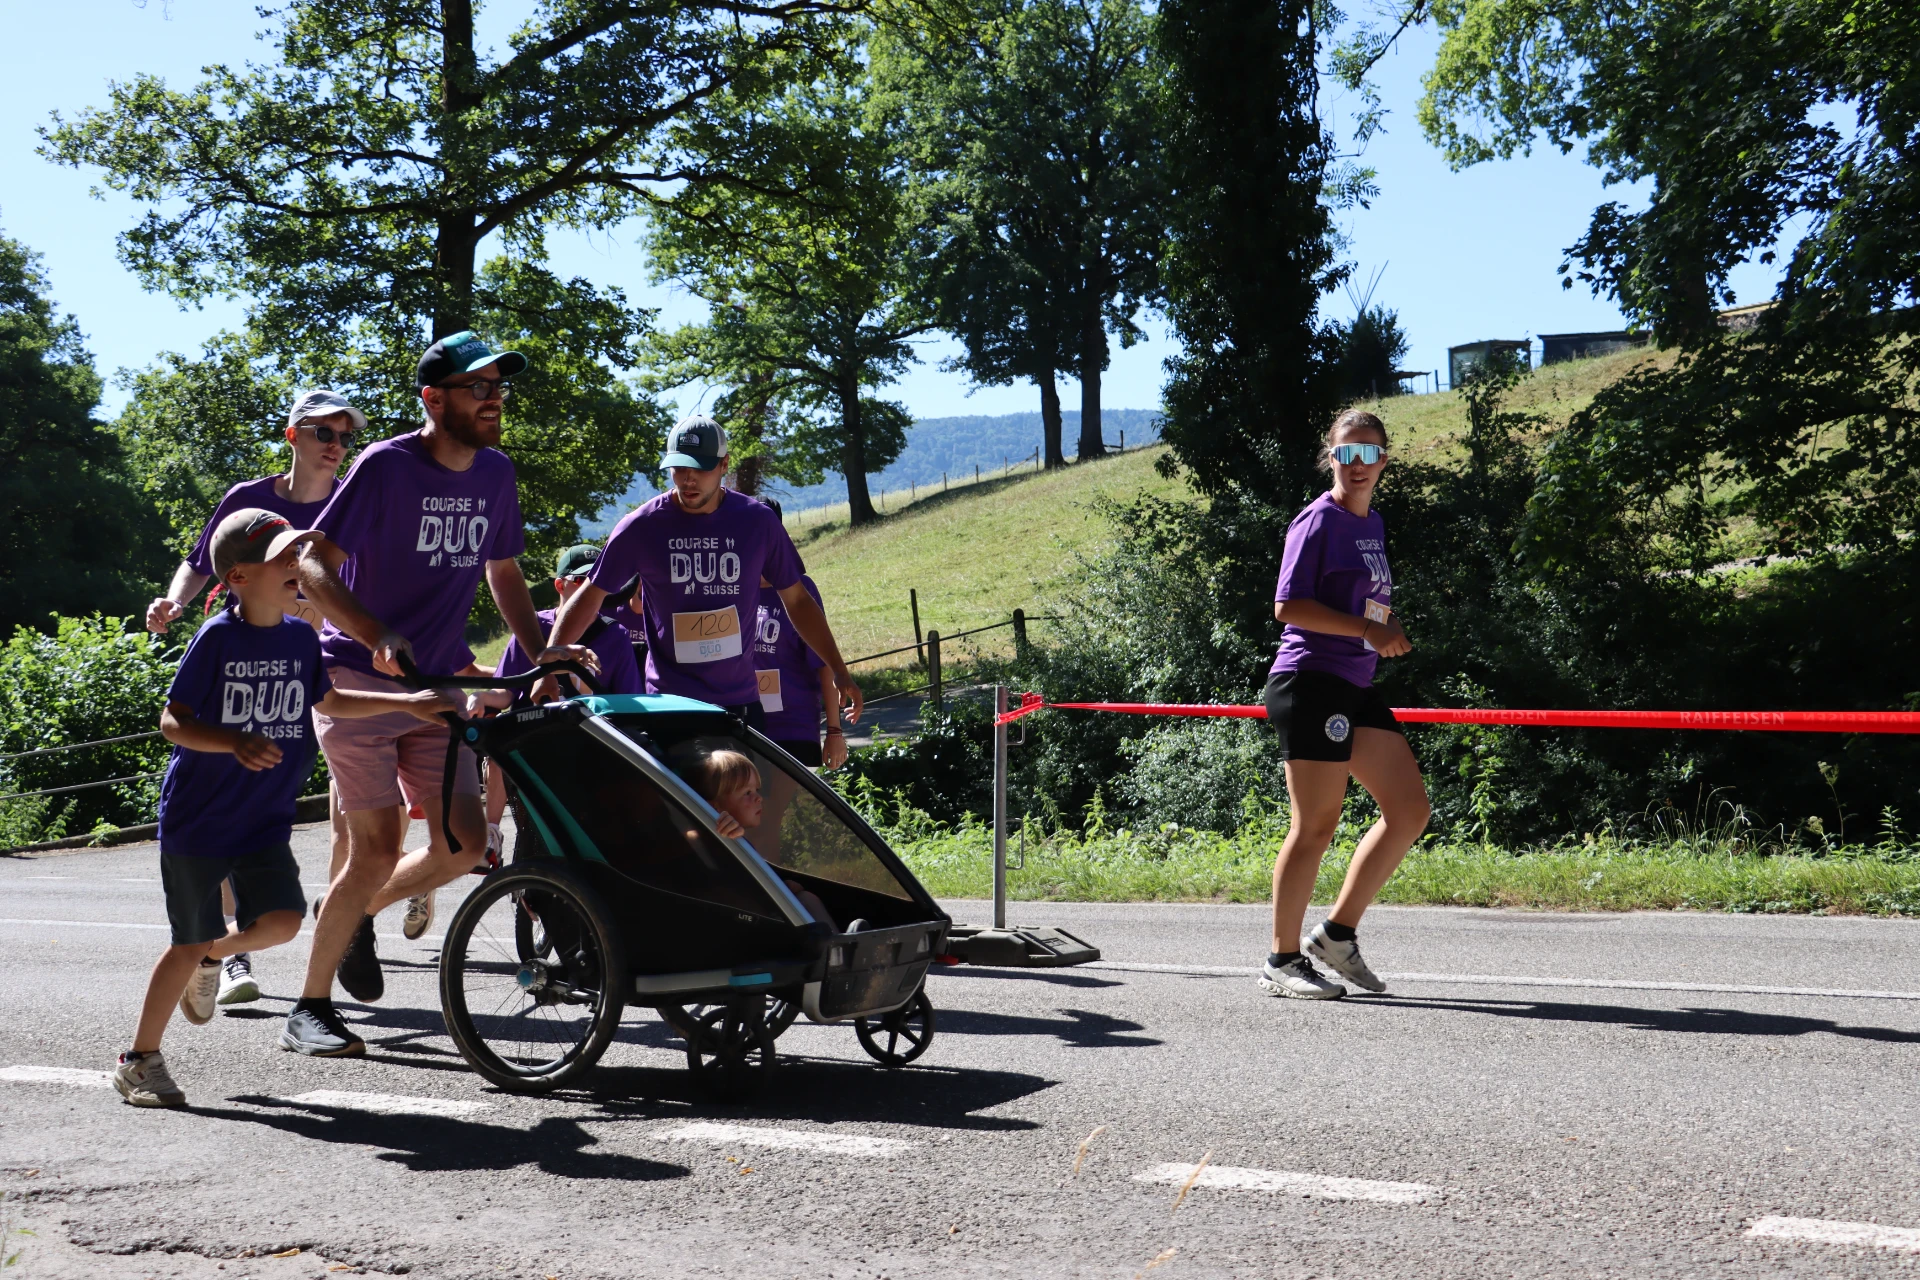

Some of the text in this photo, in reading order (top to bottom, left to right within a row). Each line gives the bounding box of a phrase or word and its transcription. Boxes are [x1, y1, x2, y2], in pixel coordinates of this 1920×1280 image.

[422, 497, 473, 512] COURSE
[416, 515, 489, 553] DUO
[668, 537, 719, 550] COURSE
[670, 552, 741, 583] DUO
[1362, 552, 1392, 584] DU
[703, 584, 740, 596] SUISSE
[691, 613, 732, 637] 120
[224, 660, 288, 678] COURSE
[221, 680, 305, 723] DUO
[516, 709, 545, 723] THULE
[1680, 711, 1785, 725] RAIFFEISEN
[738, 913, 753, 922] LITE
